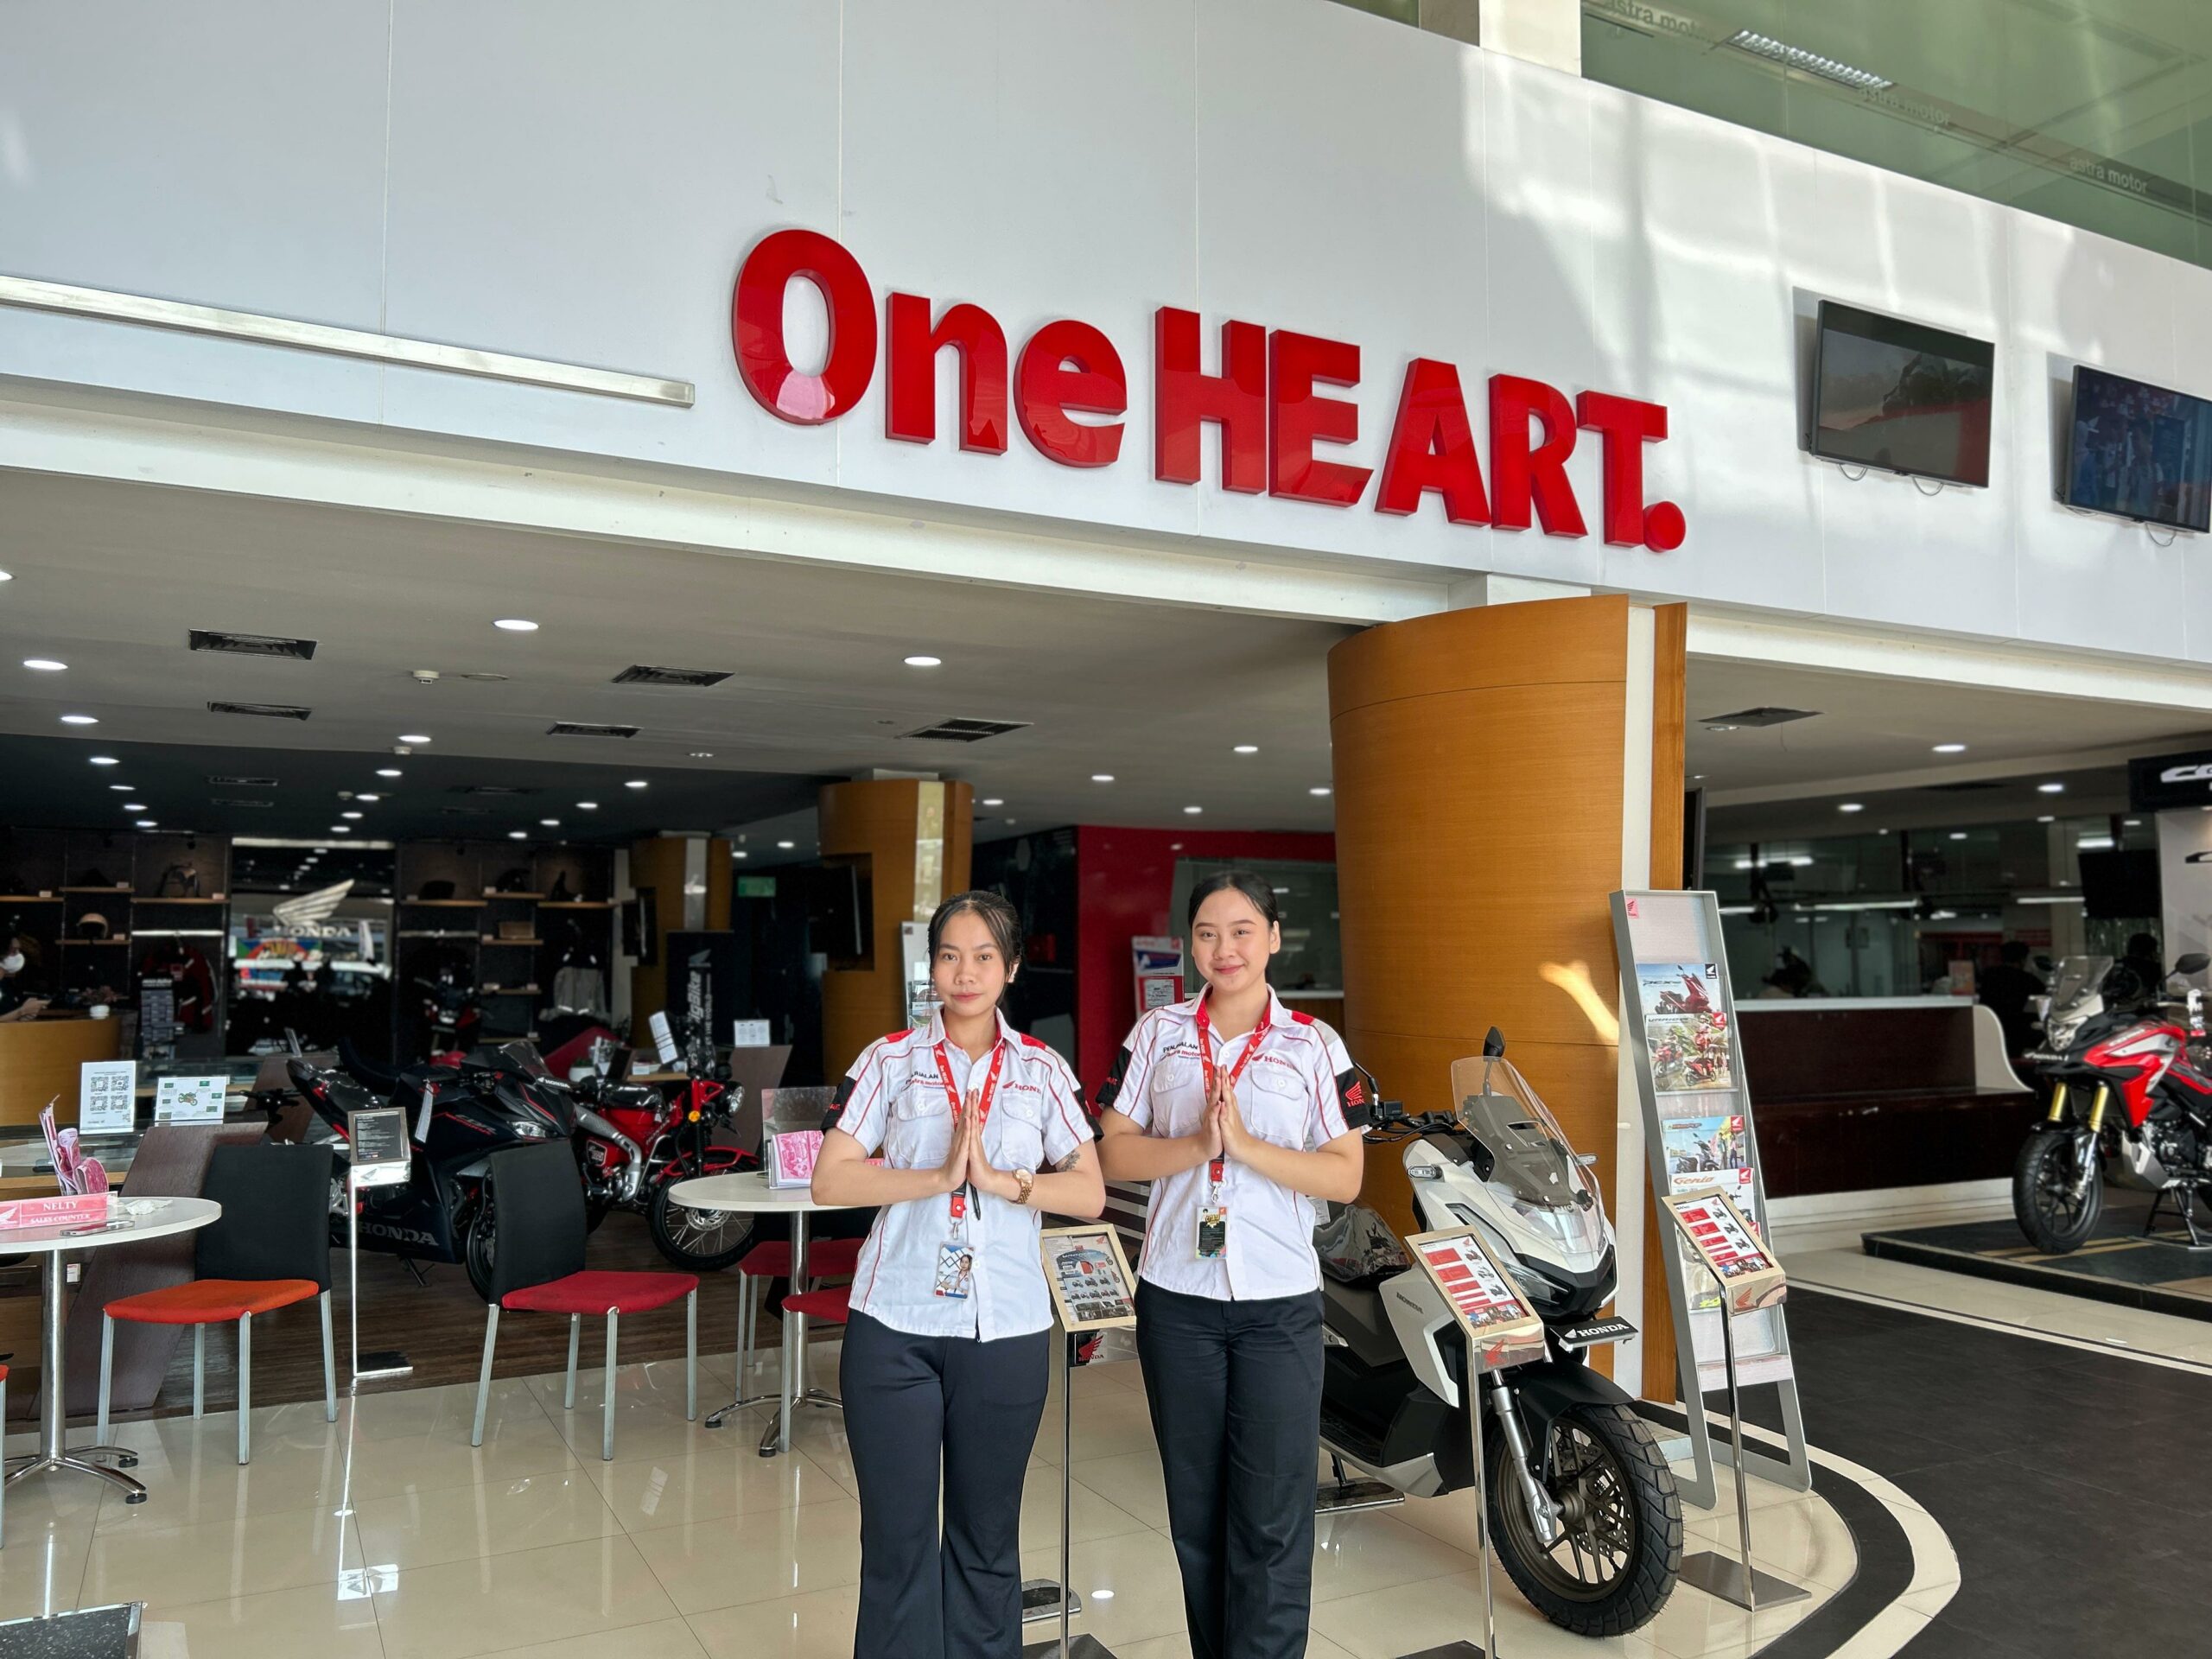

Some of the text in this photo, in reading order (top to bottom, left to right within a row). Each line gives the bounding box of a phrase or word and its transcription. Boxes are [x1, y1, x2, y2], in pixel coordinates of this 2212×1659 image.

[2107, 169, 2148, 194] motor
[731, 228, 1128, 469] One
[1673, 1176, 1716, 1185] Genio
[42, 1201, 79, 1211] NELTY
[30, 1213, 91, 1224] SALES COUNTER
[357, 1220, 440, 1247] HONDA
[1396, 1291, 1424, 1314] HONDA
[1576, 1323, 1630, 1337] HONDA
